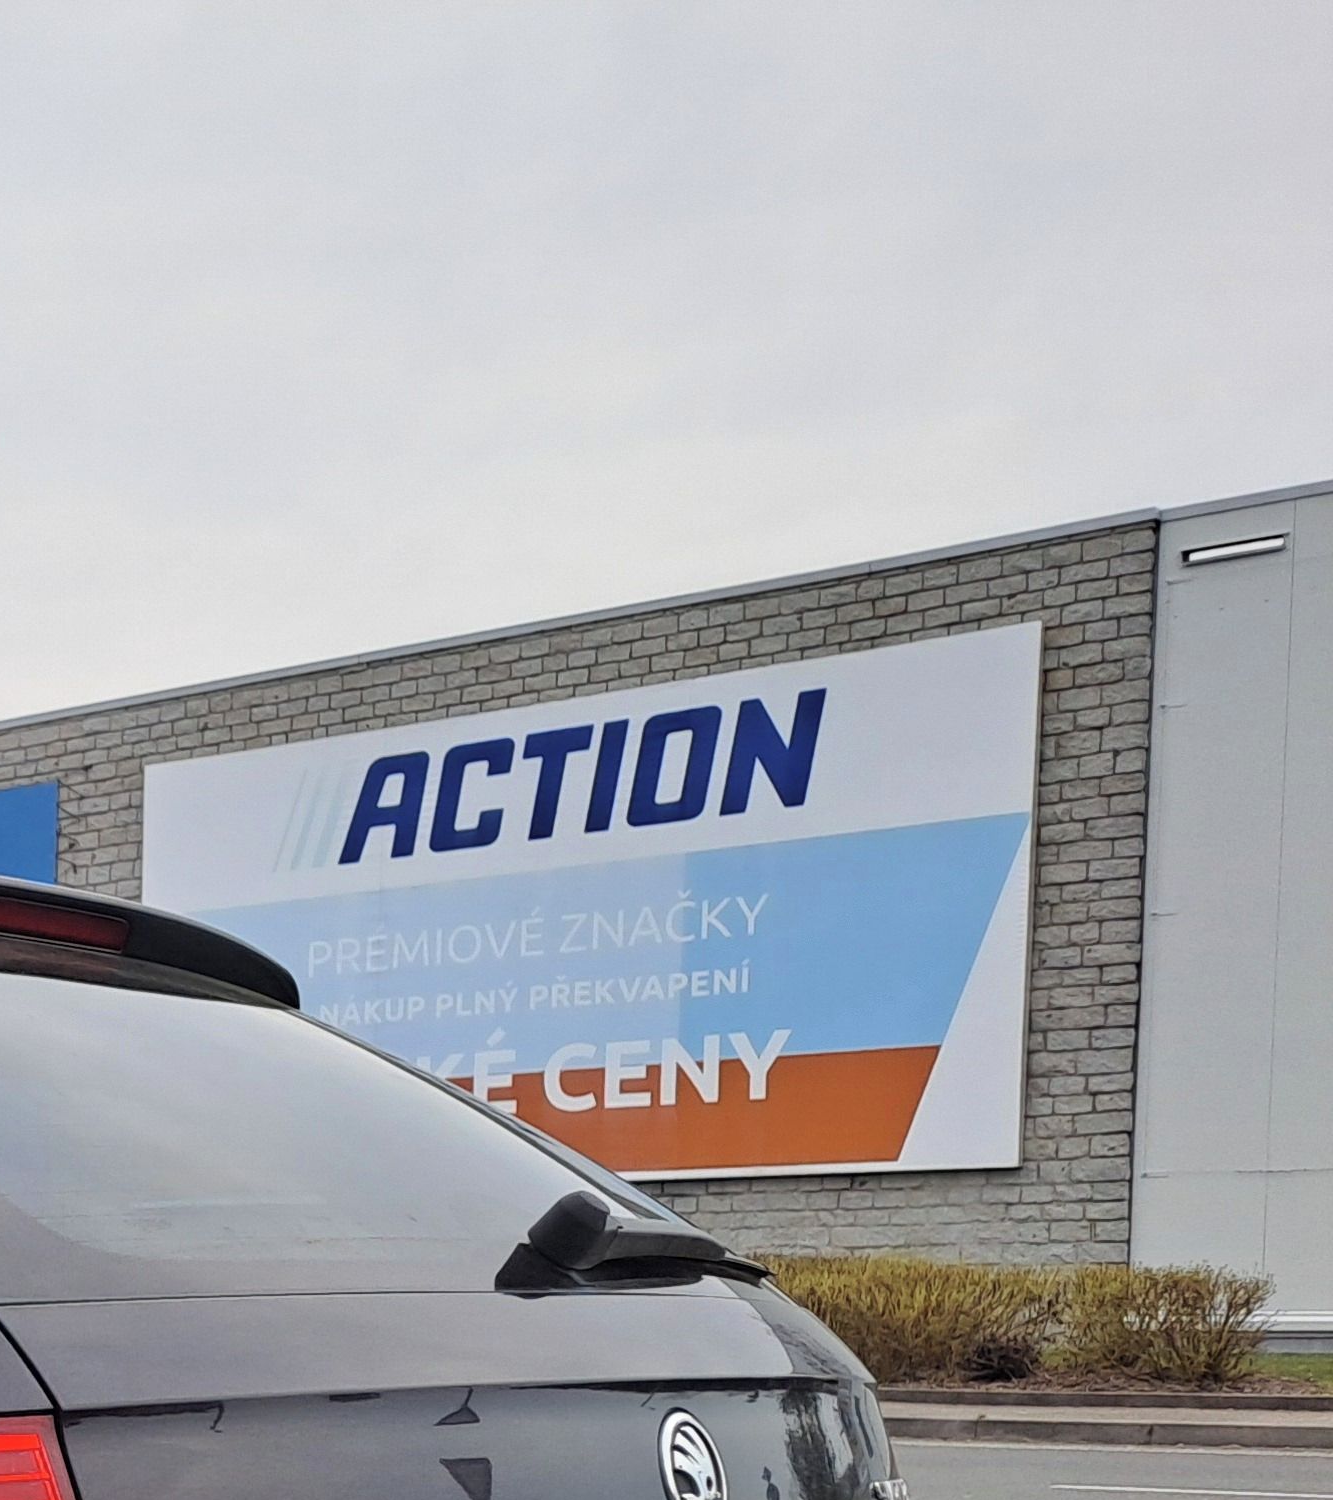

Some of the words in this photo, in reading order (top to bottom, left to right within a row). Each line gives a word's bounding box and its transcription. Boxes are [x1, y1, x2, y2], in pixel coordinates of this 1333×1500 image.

[338, 687, 828, 865] ACTION
[559, 889, 769, 953] ZNAČKY
[436, 980, 519, 1018] PLNÝ
[529, 958, 751, 1010] PŘEKVAPENÍ
[543, 1028, 792, 1112] CENY
